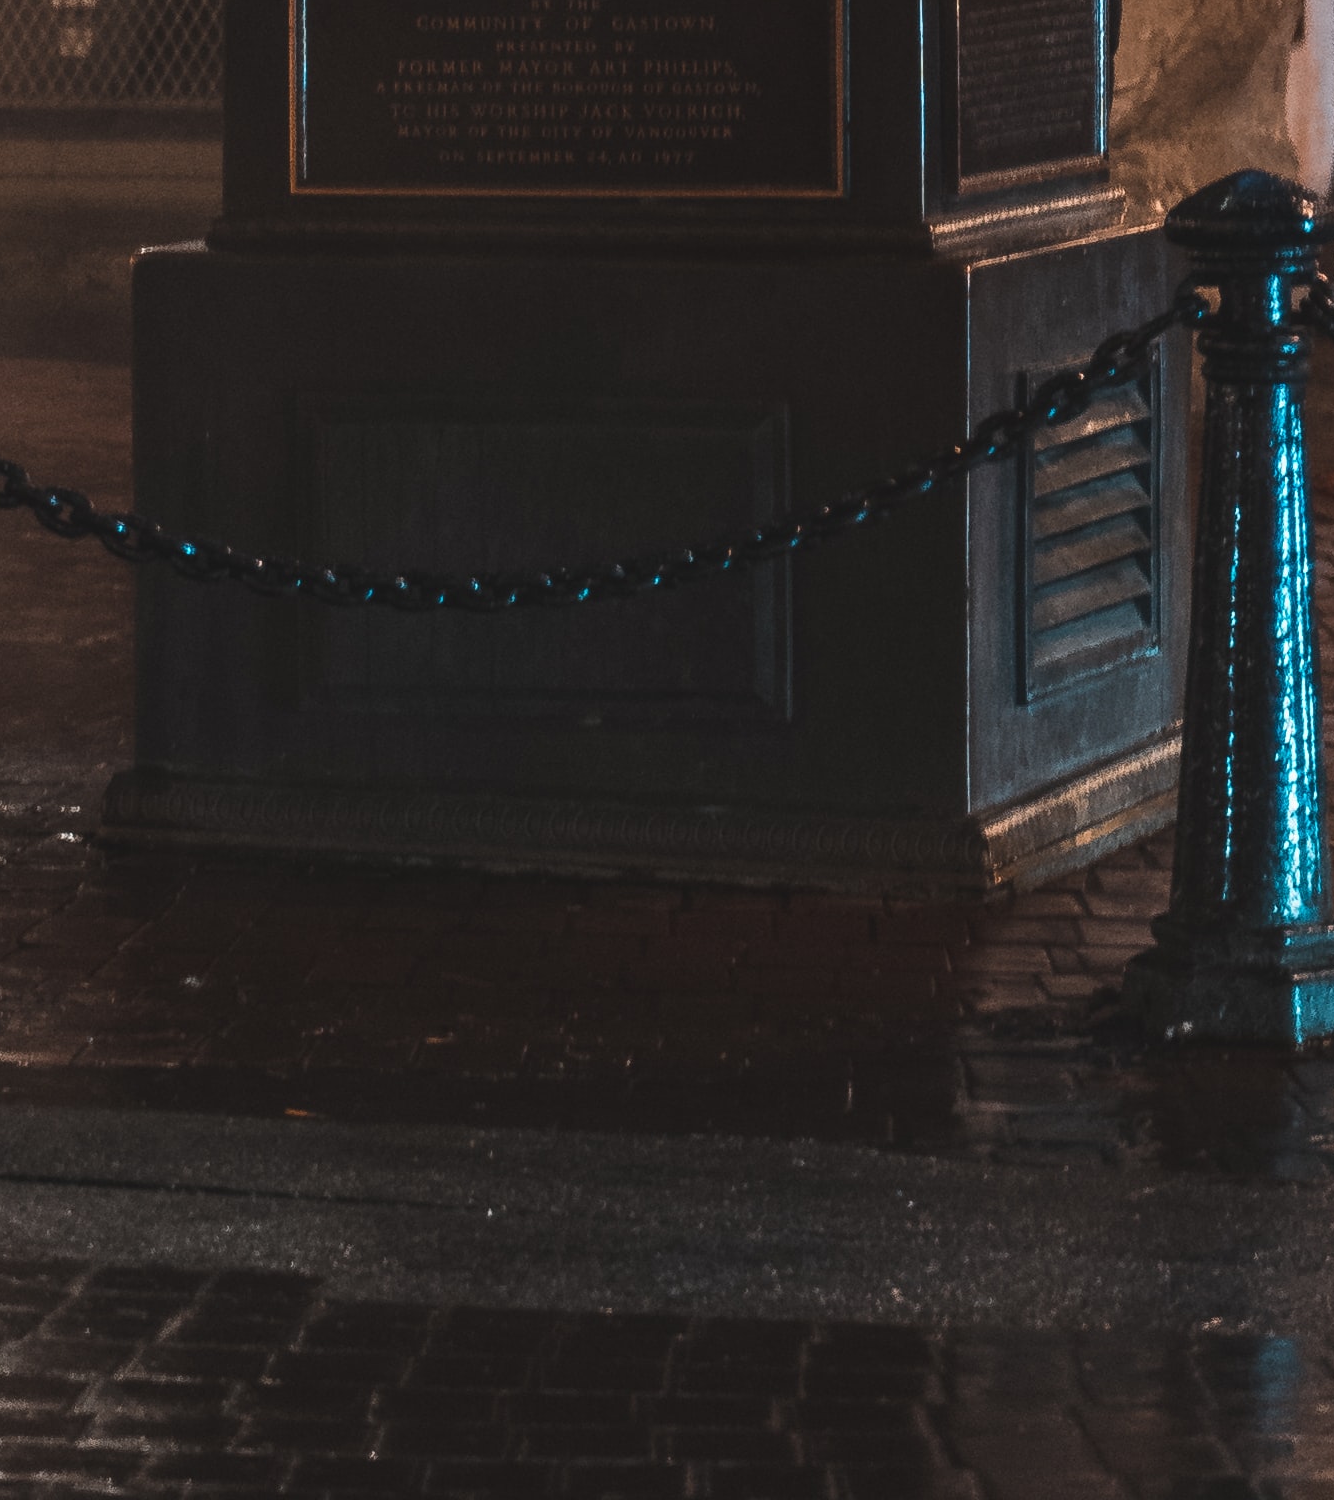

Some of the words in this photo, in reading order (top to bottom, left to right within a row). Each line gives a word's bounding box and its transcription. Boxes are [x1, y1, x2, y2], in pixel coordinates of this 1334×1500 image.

[415, 14, 544, 32] COMMUNITY
[564, 14, 593, 32] OF
[612, 39, 637, 54] BY
[396, 58, 484, 78] FORMER
[498, 58, 575, 78] MAYOR
[589, 58, 630, 78] ART
[374, 80, 387, 97] A
[392, 80, 475, 97] FREEMAN
[481, 80, 503, 97] OF
[510, 80, 543, 97] THE
[551, 80, 635, 97] BOROUGH
[642, 80, 665, 97] OF
[389, 102, 416, 121] TO
[425, 102, 461, 121] HIS
[470, 102, 571, 121] WORSHIP
[580, 102, 633, 121] JACK
[396, 124, 459, 139] MAYOR
[467, 124, 489, 139] OF
[497, 124, 532, 139] THE
[540, 124, 584, 139] CITY
[590, 124, 613, 139] OF
[623, 124, 734, 139] VANCOUVER
[438, 150, 465, 165] ON
[476, 150, 576, 165] SEPTEMBER
